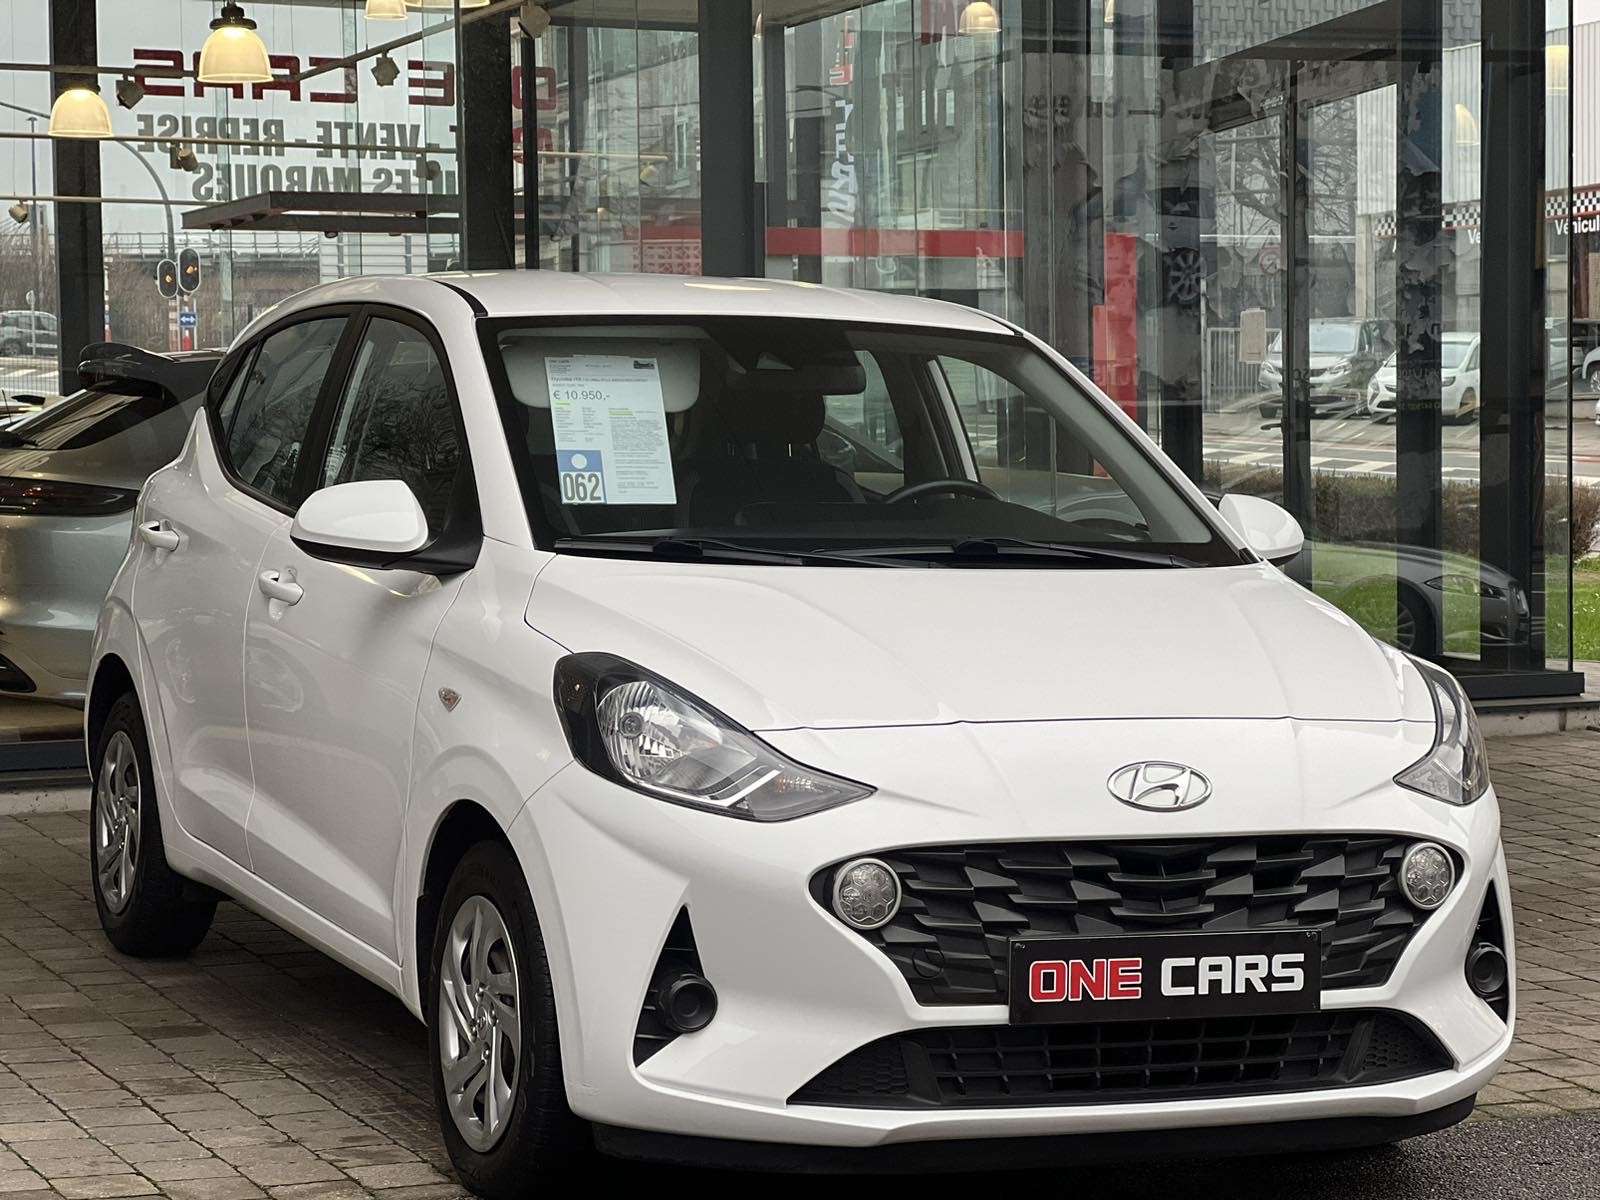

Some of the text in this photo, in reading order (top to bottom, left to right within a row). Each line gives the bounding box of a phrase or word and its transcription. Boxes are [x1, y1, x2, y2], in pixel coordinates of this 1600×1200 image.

[553, 390, 561, 400] €
[562, 472, 602, 502] 062
[1029, 953, 1305, 1003] ONE CARS
